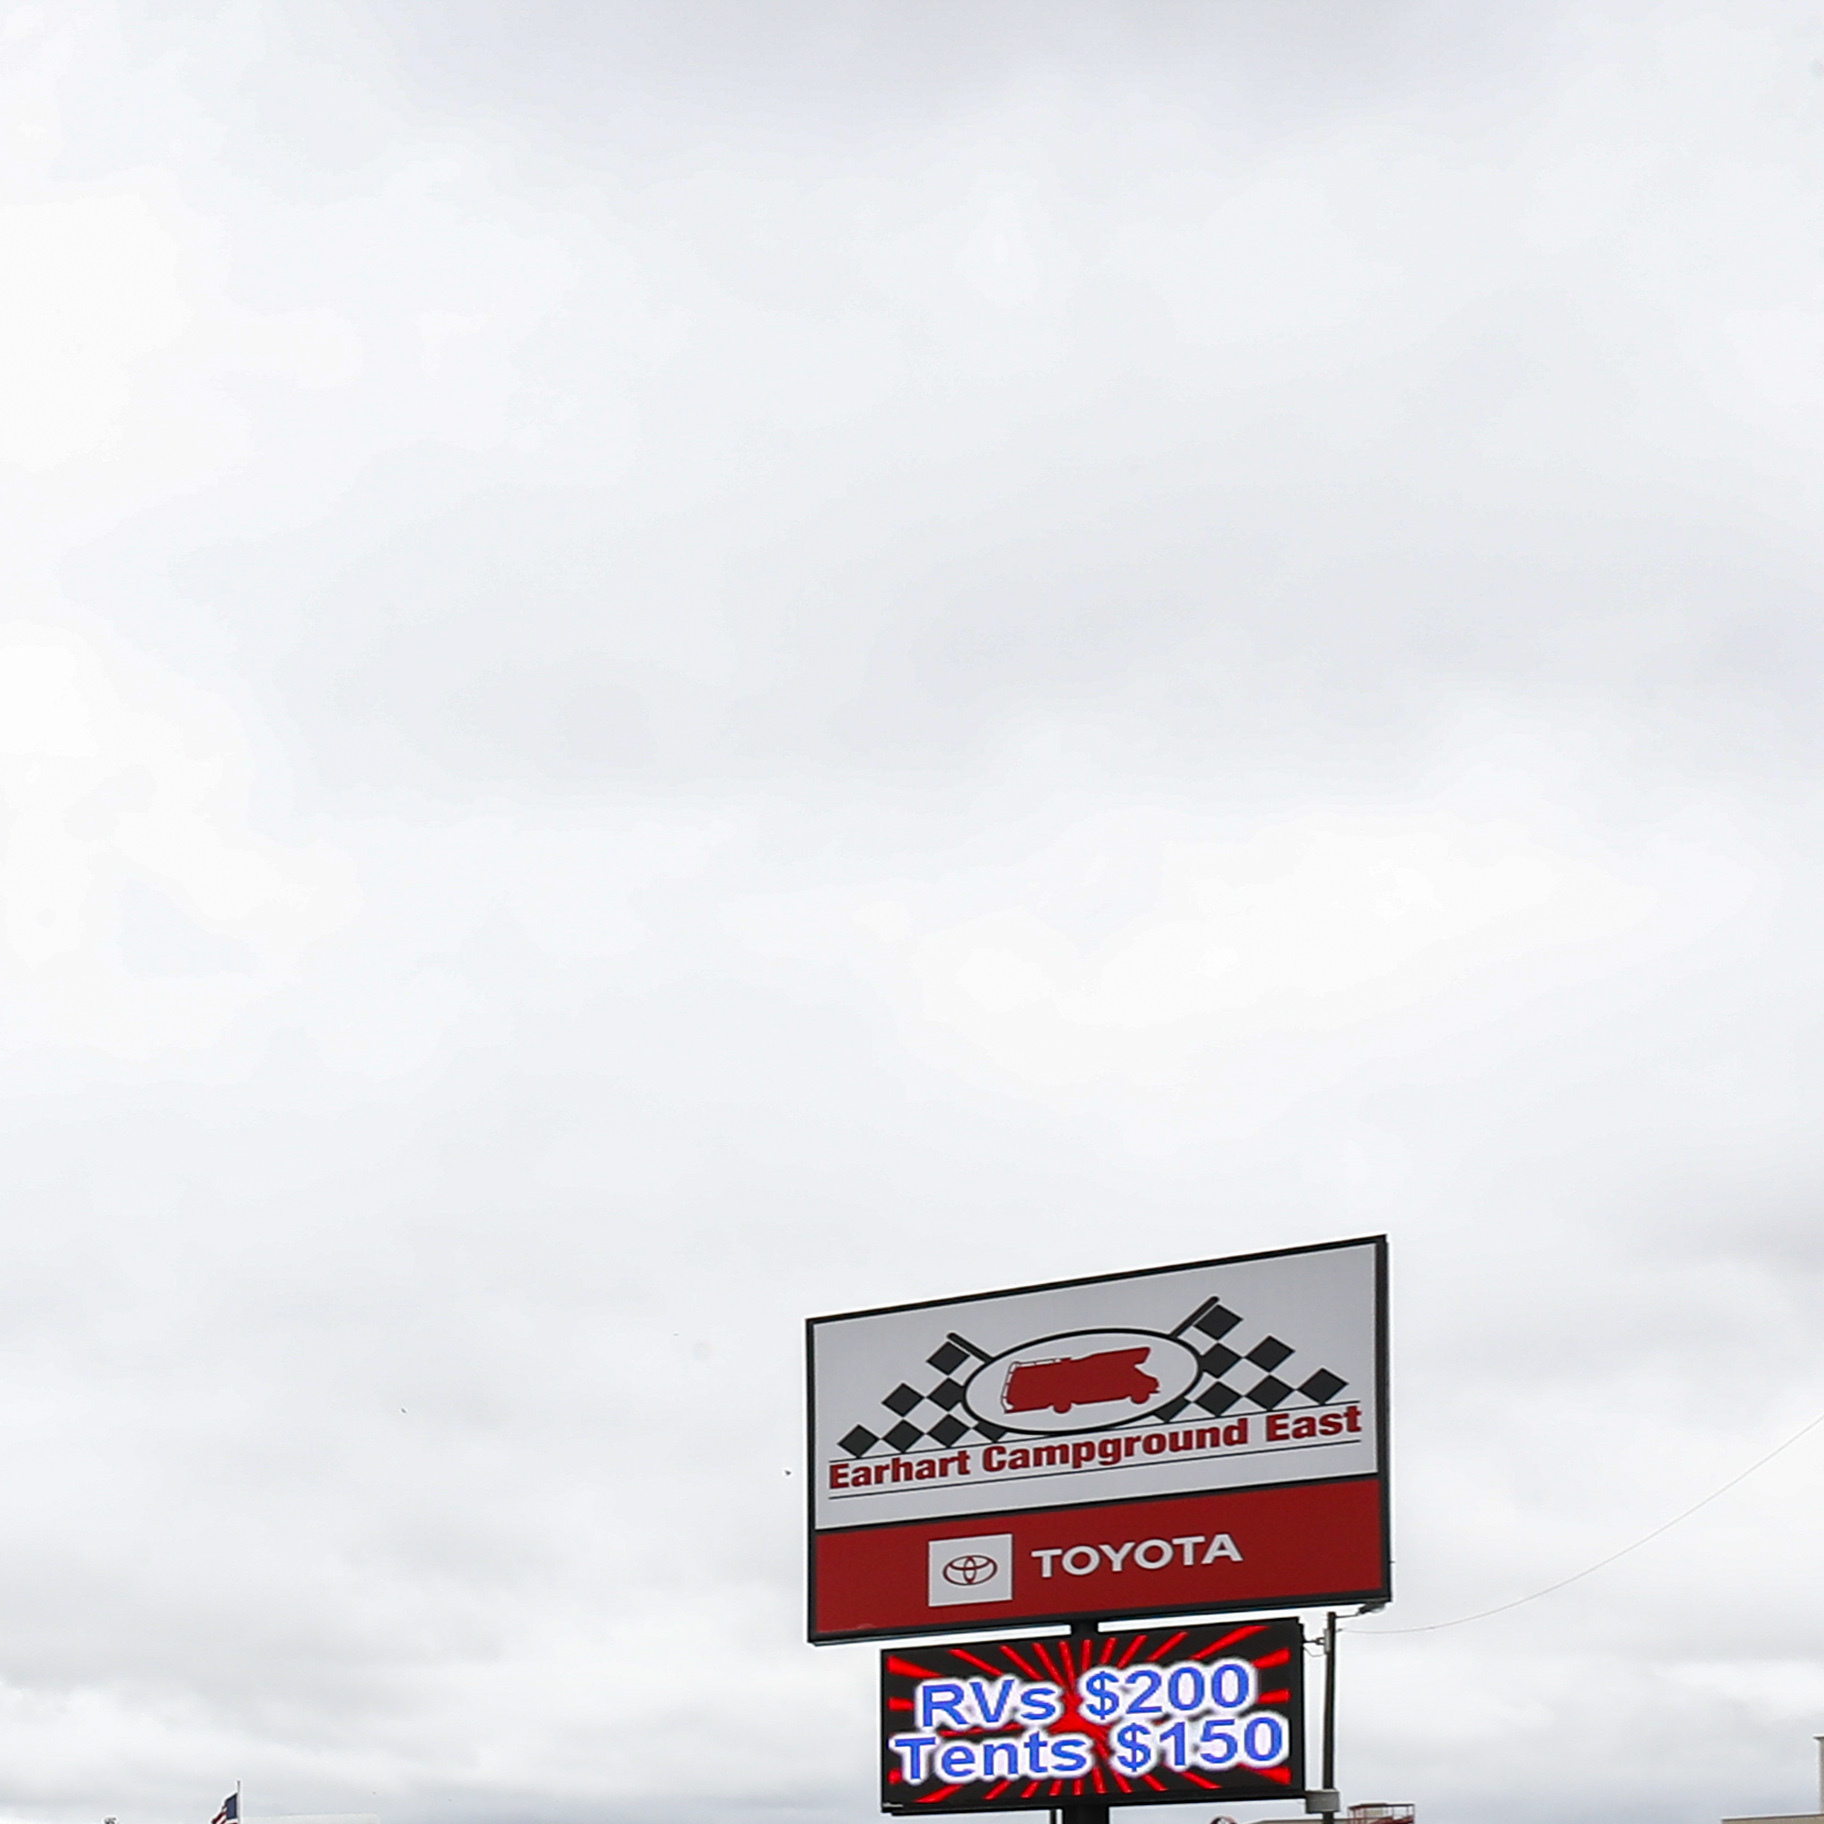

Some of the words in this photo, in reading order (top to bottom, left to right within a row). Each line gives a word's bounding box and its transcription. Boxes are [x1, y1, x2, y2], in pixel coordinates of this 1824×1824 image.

[828, 1446, 971, 1490] Earhart
[981, 1416, 1249, 1472] Campground
[1266, 1404, 1362, 1443] East
[1031, 1532, 1242, 1579] TOYOTA
[920, 1675, 1059, 1729] RVs
[1083, 1662, 1252, 1721] $200
[893, 1730, 1088, 1783] Tents
[1116, 1715, 1285, 1773] $150
